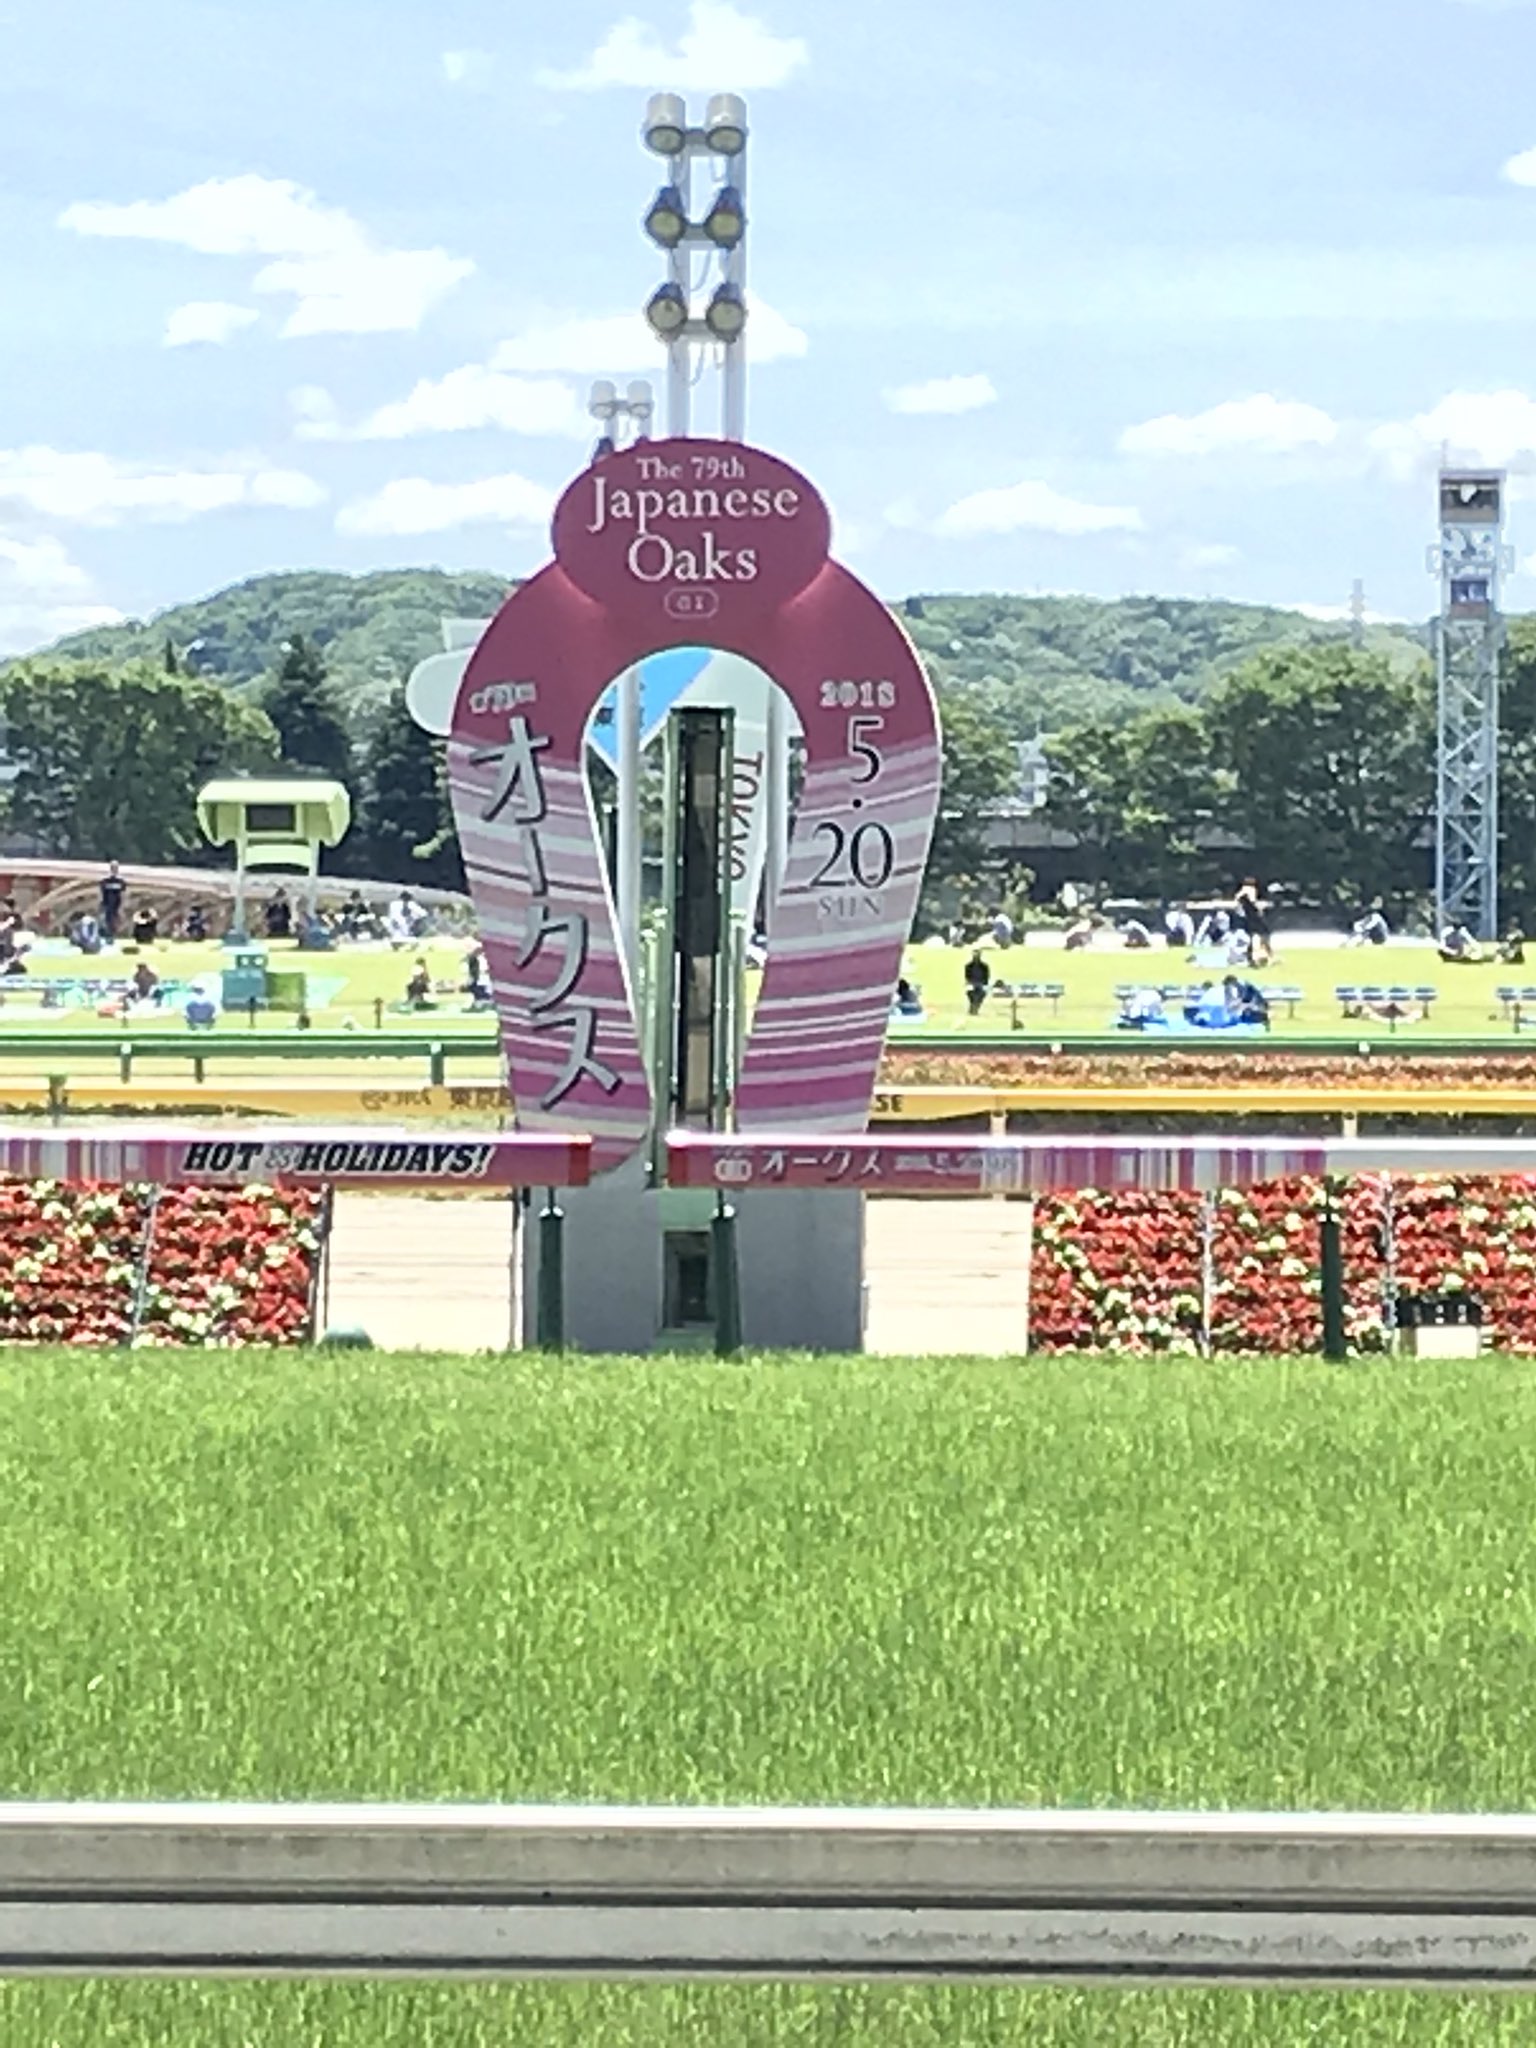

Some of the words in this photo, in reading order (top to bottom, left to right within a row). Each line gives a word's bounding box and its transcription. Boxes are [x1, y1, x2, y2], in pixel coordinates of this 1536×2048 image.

[636, 456, 683, 480] The
[690, 455, 746, 480] 79th
[586, 476, 799, 534] Japanese
[628, 531, 758, 582] Oaks
[819, 681, 896, 709] 2018
[470, 716, 623, 1111] オークス
[183, 1143, 264, 1172] HOT
[297, 1143, 492, 1175] HOLIDAYS!
[760, 1148, 882, 1180] オークス
